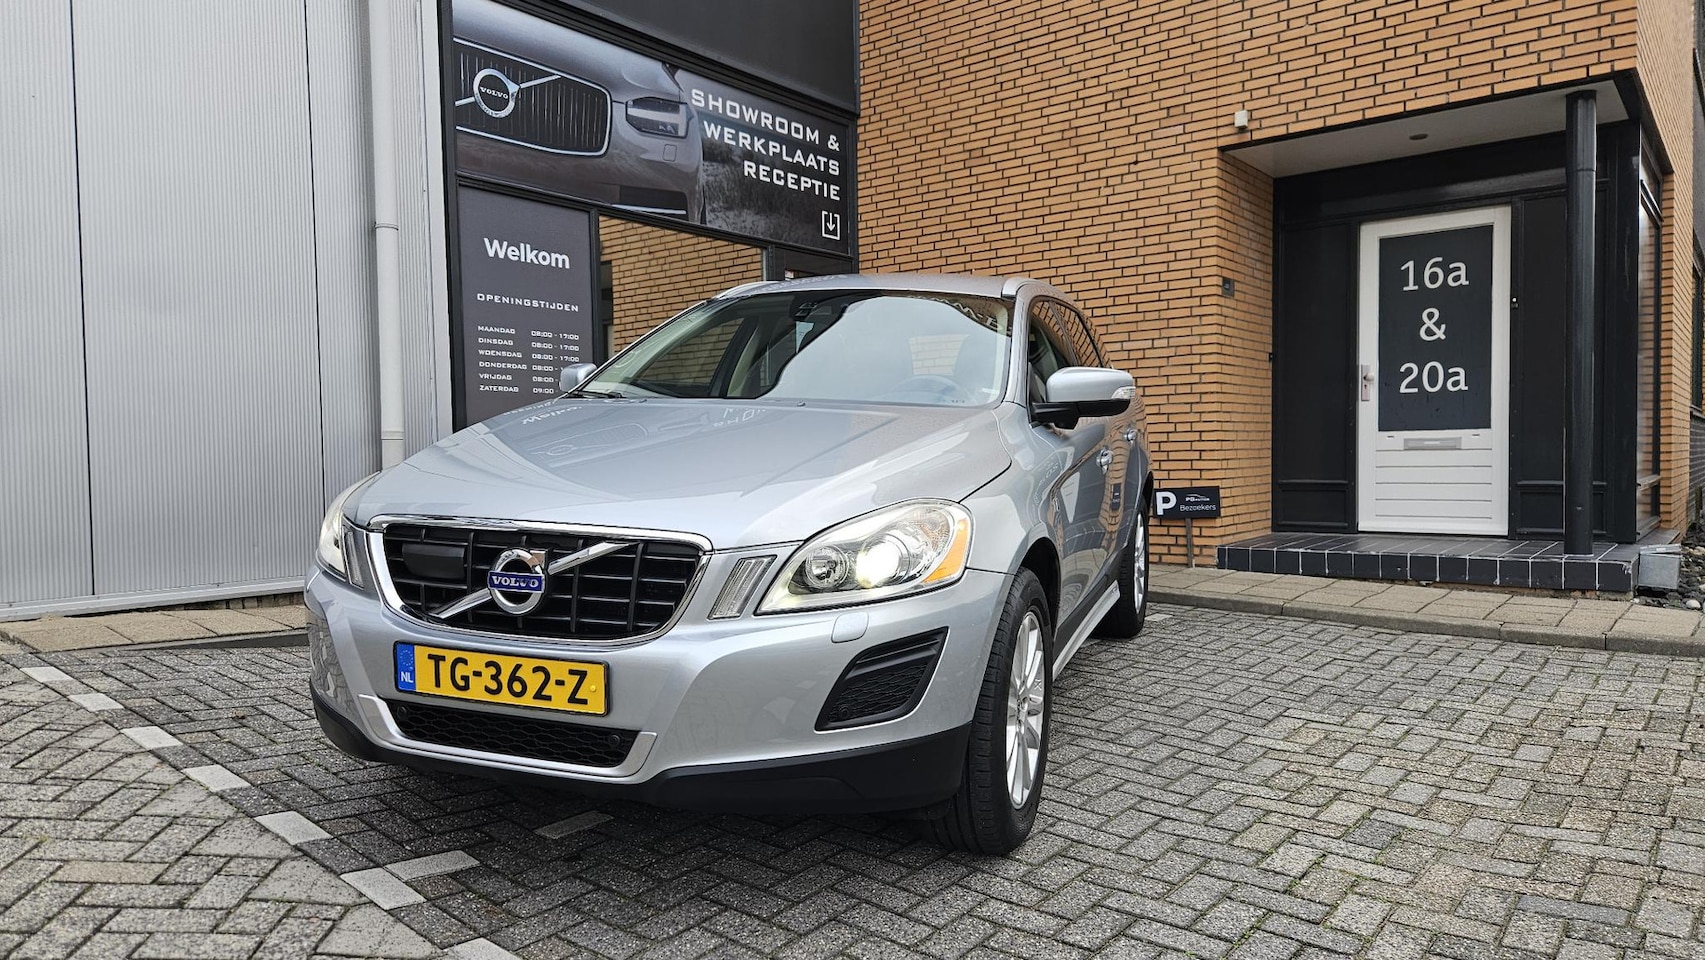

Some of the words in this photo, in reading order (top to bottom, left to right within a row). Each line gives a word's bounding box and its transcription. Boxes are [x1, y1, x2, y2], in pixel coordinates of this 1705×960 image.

[480, 86, 509, 99] VOLVO
[691, 88, 820, 145] SHOWROOM
[827, 135, 840, 152] &
[703, 120, 840, 176] WERKPLAATS
[743, 160, 841, 201] RECEPTIE
[483, 237, 570, 269] Welkom
[1400, 256, 1470, 291] 16a
[476, 293, 579, 312] OPENINGSTIJDEN
[477, 325, 516, 335] MAANDAG
[531, 330, 553, 338] 08:00
[1419, 307, 1446, 341] &
[478, 337, 514, 346] DINSDAG
[478, 349, 523, 358] WOENSDAG
[478, 361, 528, 370] DONDERDAG
[479, 373, 513, 381] VRIJDAG
[1399, 361, 1469, 394] 20a
[479, 384, 519, 393] ZATERDAG
[1155, 491, 1177, 516] P
[1179, 504, 1217, 512] Bezoekers
[491, 574, 540, 588] VOLVO
[400, 670, 414, 684] NL
[427, 653, 589, 706] TG-362-Z
